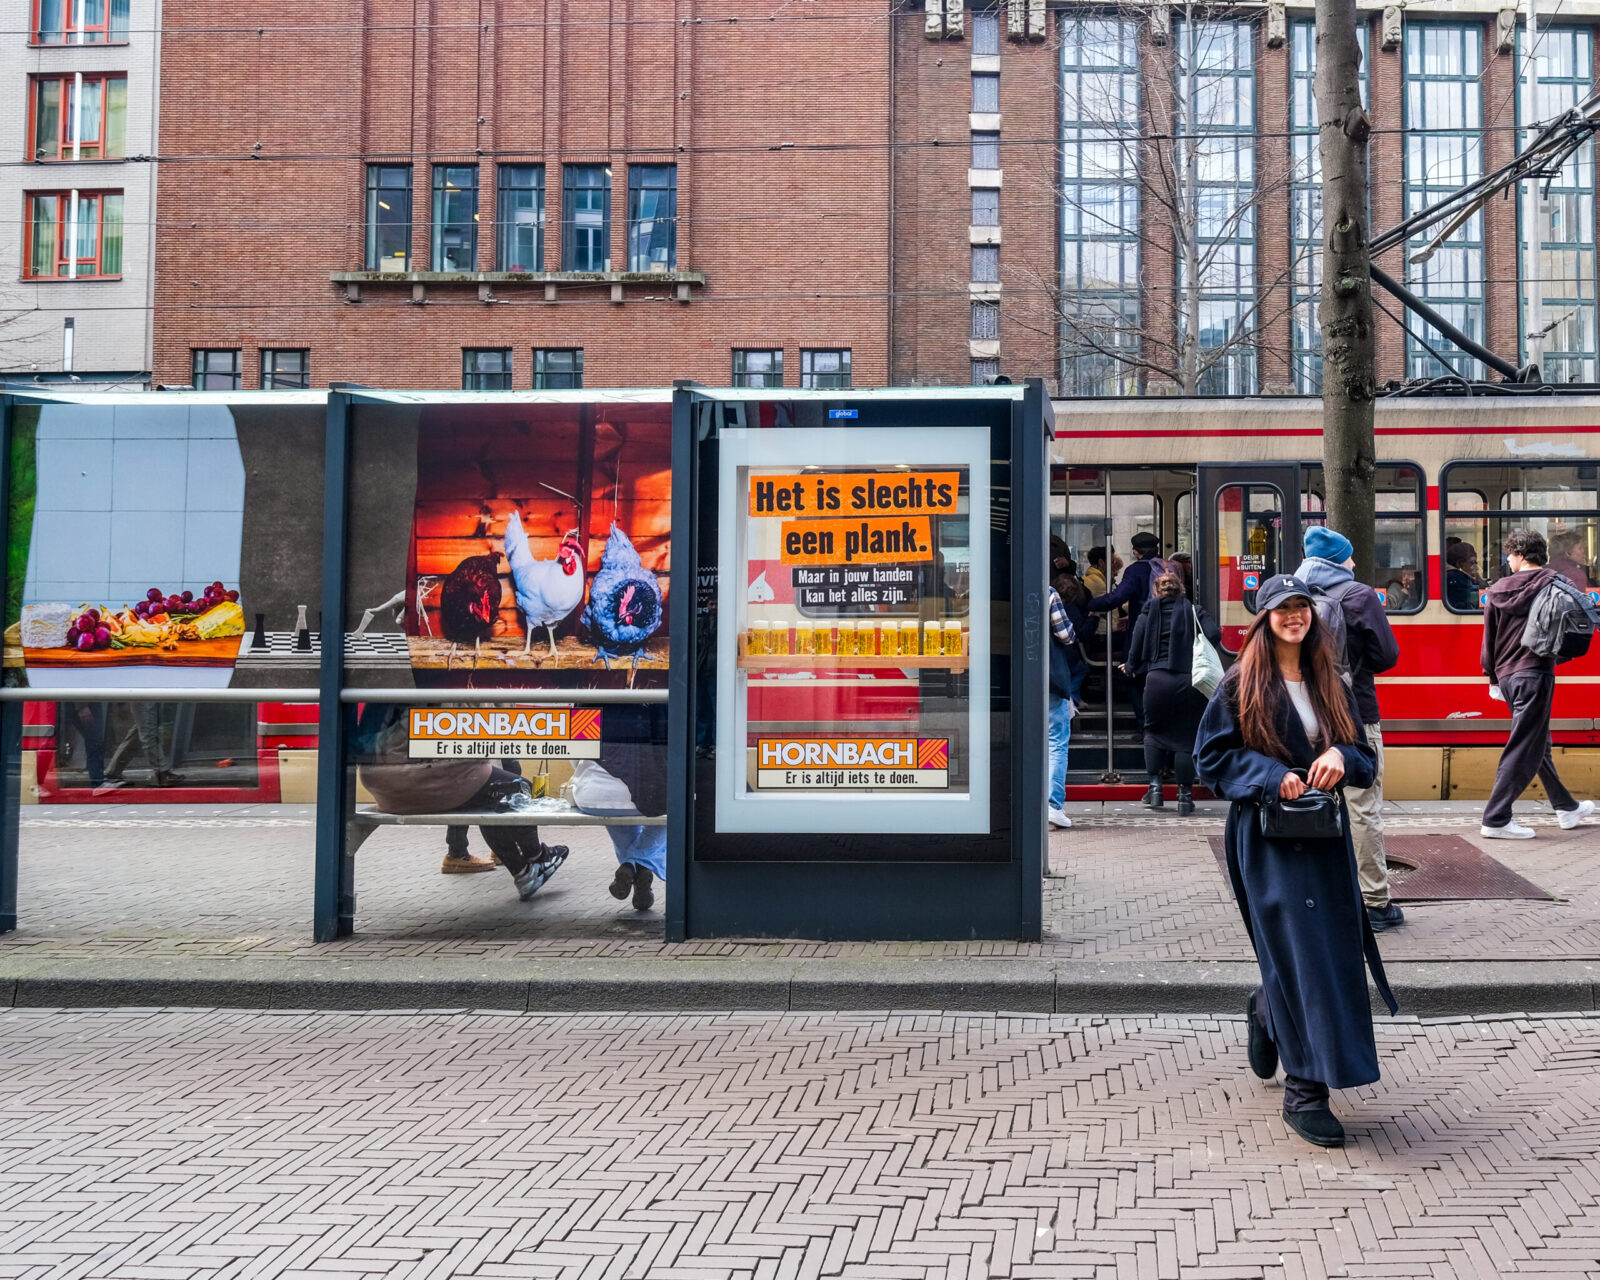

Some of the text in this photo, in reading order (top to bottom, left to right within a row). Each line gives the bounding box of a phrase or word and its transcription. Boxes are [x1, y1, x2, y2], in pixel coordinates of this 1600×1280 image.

[756, 478, 953, 512] Het is slechts
[786, 522, 928, 561] een plank.
[798, 568, 913, 585] Maar in jouw handen
[806, 587, 907, 605] kan het alles zijn.
[413, 712, 566, 736] HORNBACH
[437, 741, 571, 757] Er is altijd iets te doen.
[762, 742, 913, 765] HORNBACH
[786, 771, 918, 787] Er is altijd iets te doen.
